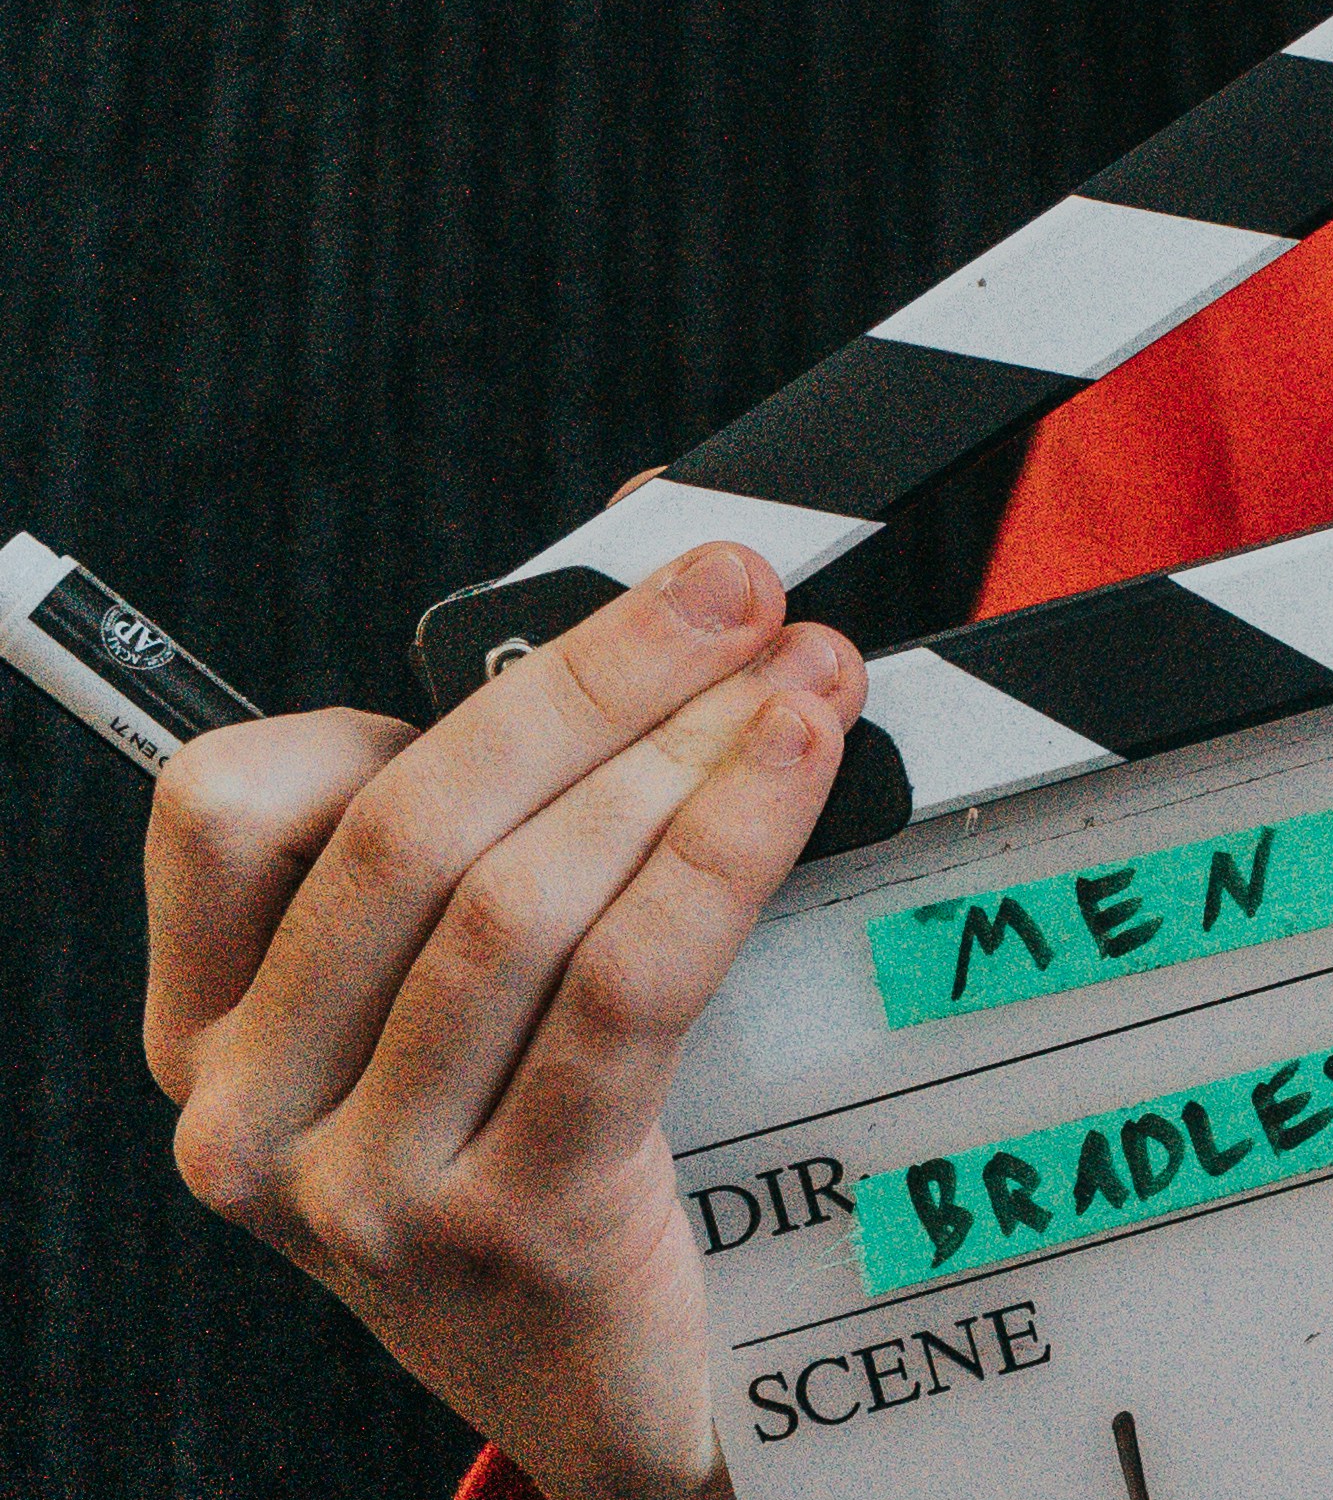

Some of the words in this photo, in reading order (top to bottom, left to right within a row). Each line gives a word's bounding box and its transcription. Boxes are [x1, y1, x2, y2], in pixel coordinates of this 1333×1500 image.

[114, 621, 165, 653] AP
[130, 732, 159, 760] EN
[952, 826, 1275, 1000] MEN
[746, 1301, 1053, 1445] SCENE
